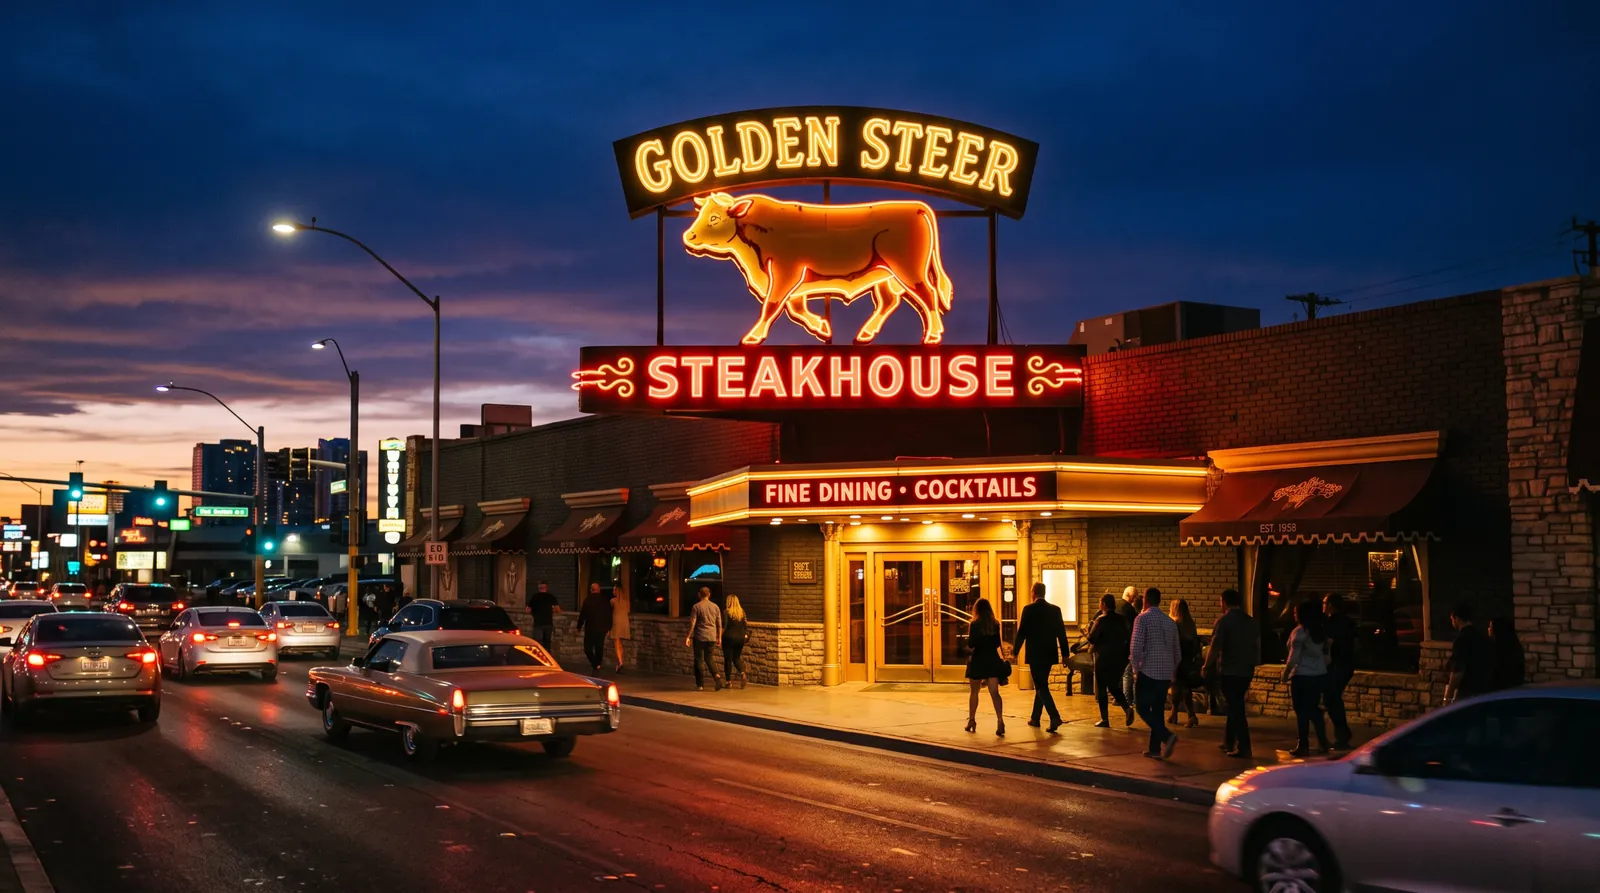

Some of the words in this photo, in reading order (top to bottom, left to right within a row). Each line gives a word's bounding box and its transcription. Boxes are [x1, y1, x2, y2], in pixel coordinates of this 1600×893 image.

[634, 115, 841, 194] GOLDEN
[860, 116, 1020, 197] STEER
[647, 355, 1016, 398] STEAKHOUSE
[765, 483, 811, 503] FINE
[818, 481, 893, 502] DINING
[913, 476, 1038, 500] COCKTAILS
[1260, 523, 1276, 534] EST.
[1278, 522, 1297, 533] 1958
